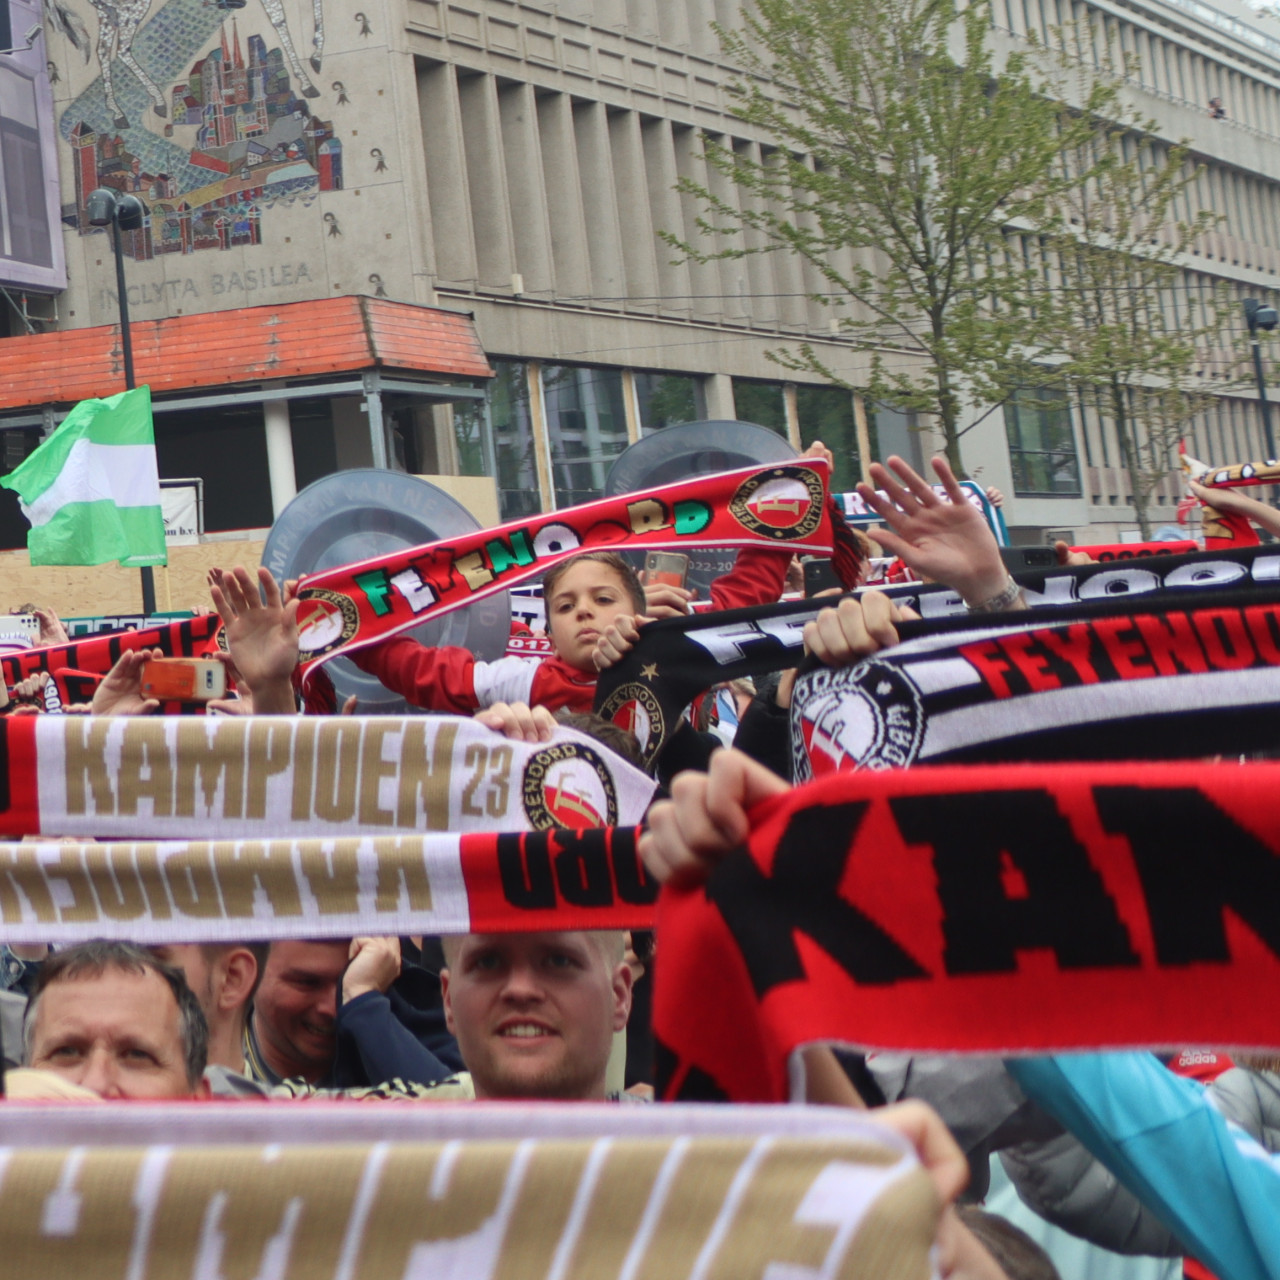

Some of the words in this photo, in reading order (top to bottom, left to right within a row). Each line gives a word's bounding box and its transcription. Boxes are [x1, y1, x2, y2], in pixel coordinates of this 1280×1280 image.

[99, 277, 201, 312] INCLYTA
[210, 261, 315, 297] BASILEA
[352, 498, 713, 617] FEYENOORD
[607, 684, 663, 734] FEYENOORD
[64, 719, 453, 829] KAMPIOEN
[460, 742, 513, 819] 23
[1179, 1052, 1218, 1066] adidas
